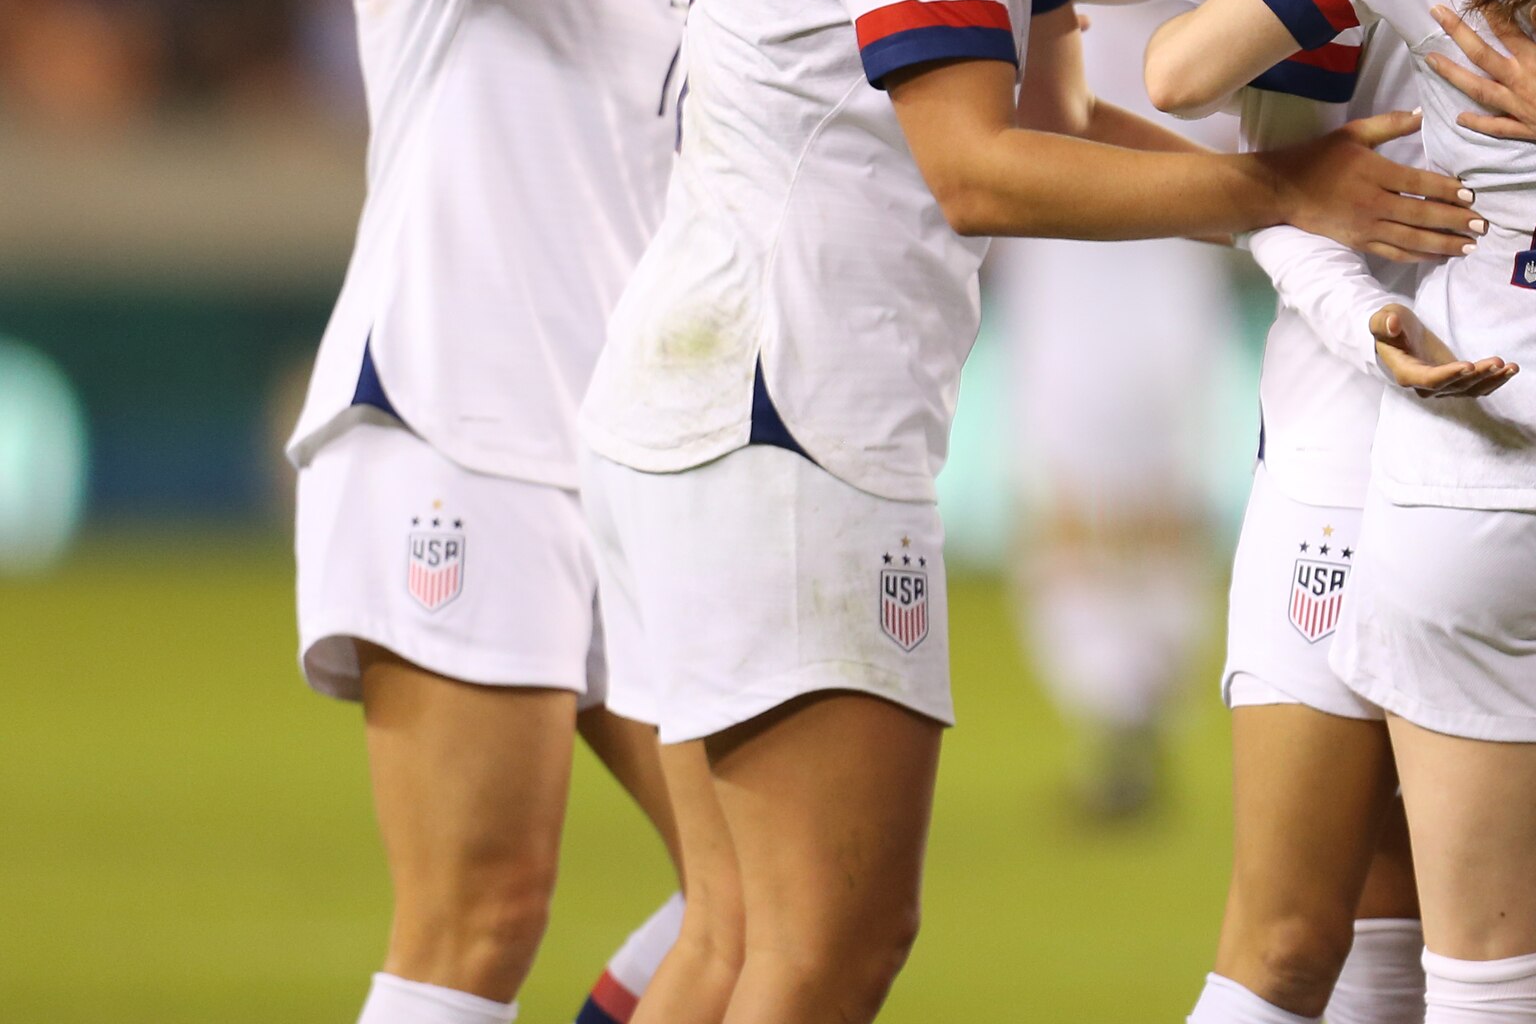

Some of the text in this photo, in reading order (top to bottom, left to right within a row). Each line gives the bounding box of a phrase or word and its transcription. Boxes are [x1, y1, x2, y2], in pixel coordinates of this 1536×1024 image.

[413, 539, 458, 567] USA
[885, 575, 924, 605] USA
[1298, 565, 1346, 596] USA
